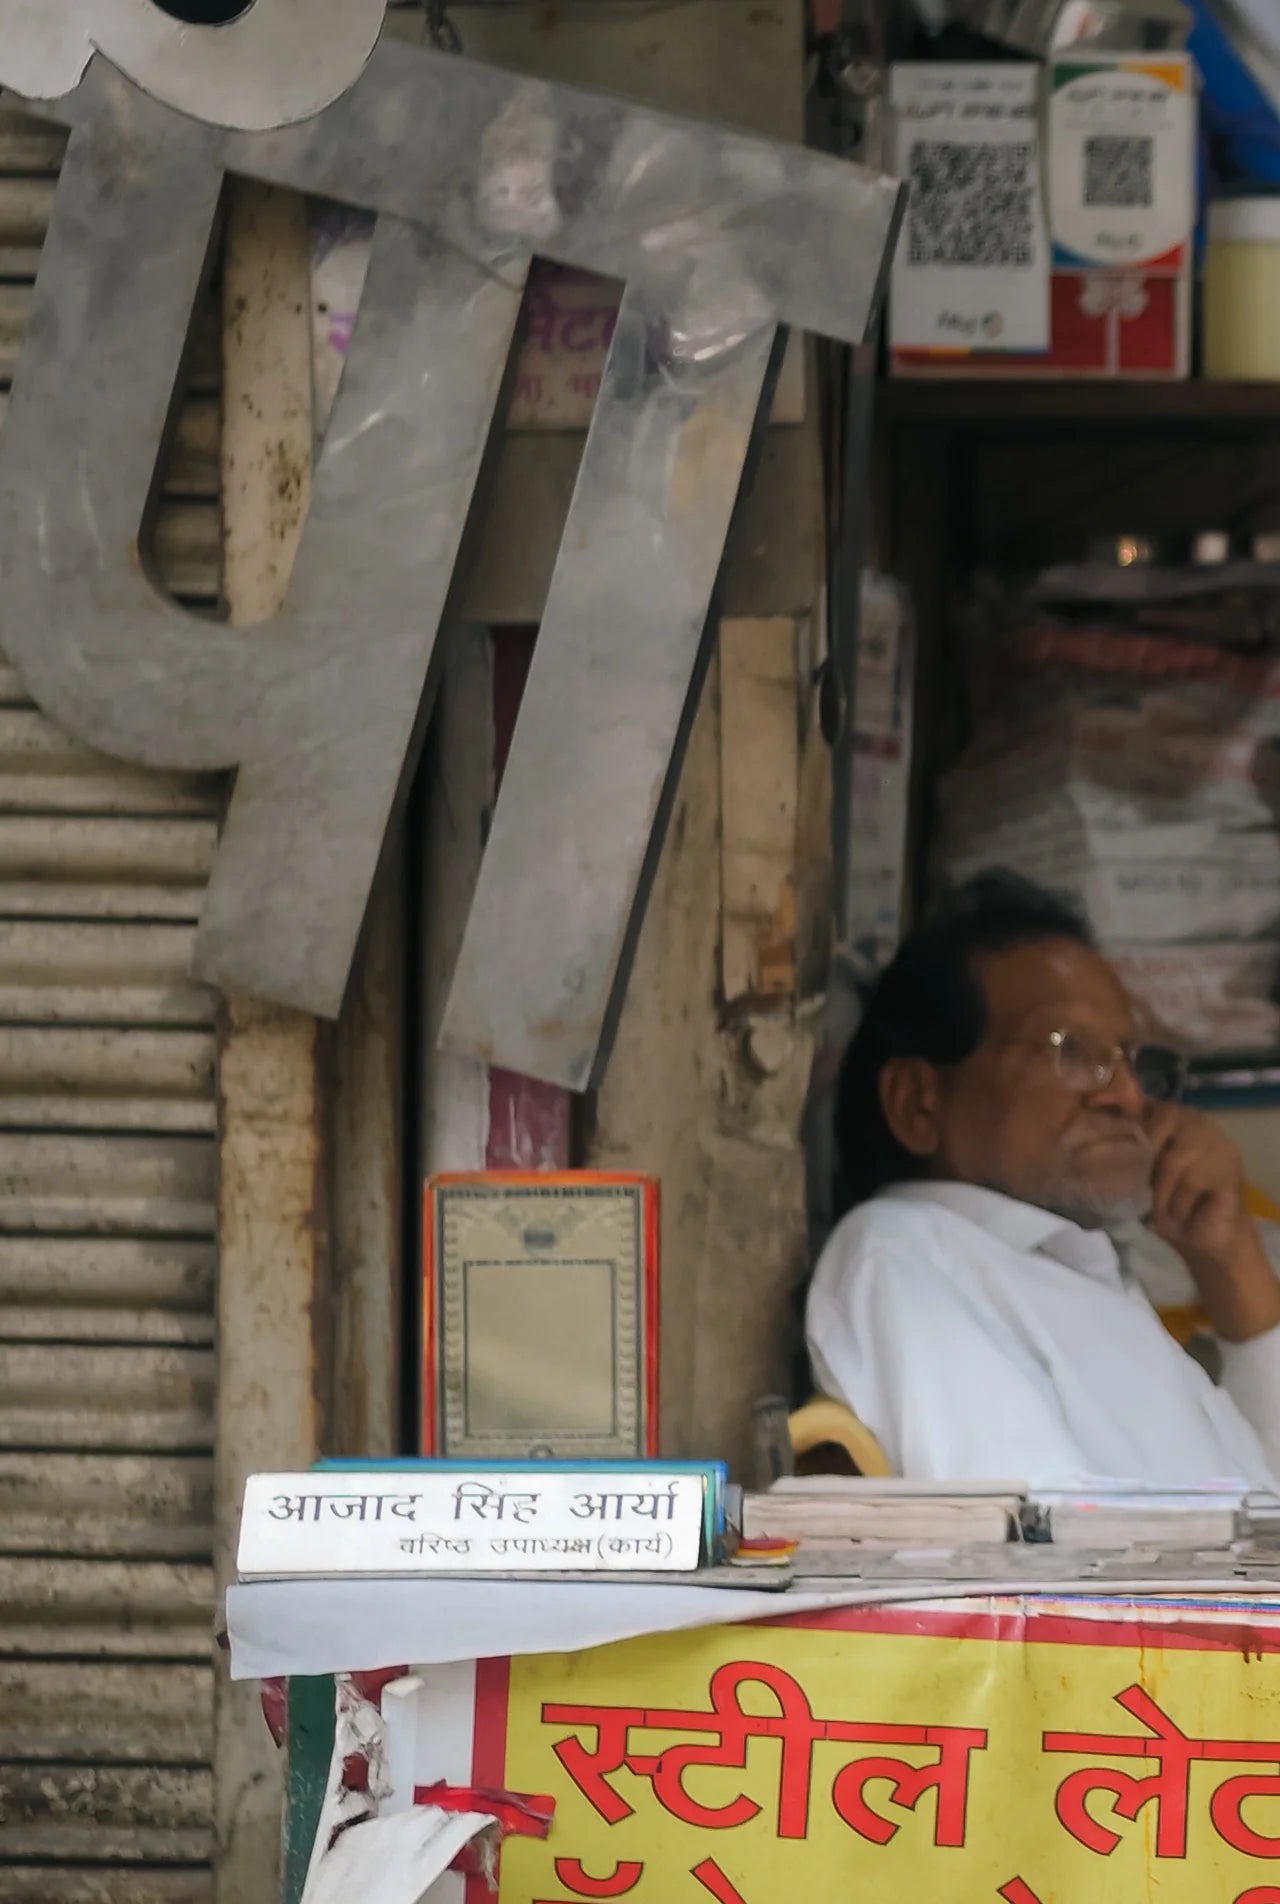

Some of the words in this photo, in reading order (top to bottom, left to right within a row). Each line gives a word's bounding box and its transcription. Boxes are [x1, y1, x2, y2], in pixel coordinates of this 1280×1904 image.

[267, 1493, 423, 1522] आजाद
[452, 1480, 542, 1524] सिंह
[539, 1660, 988, 1848] स्टील
